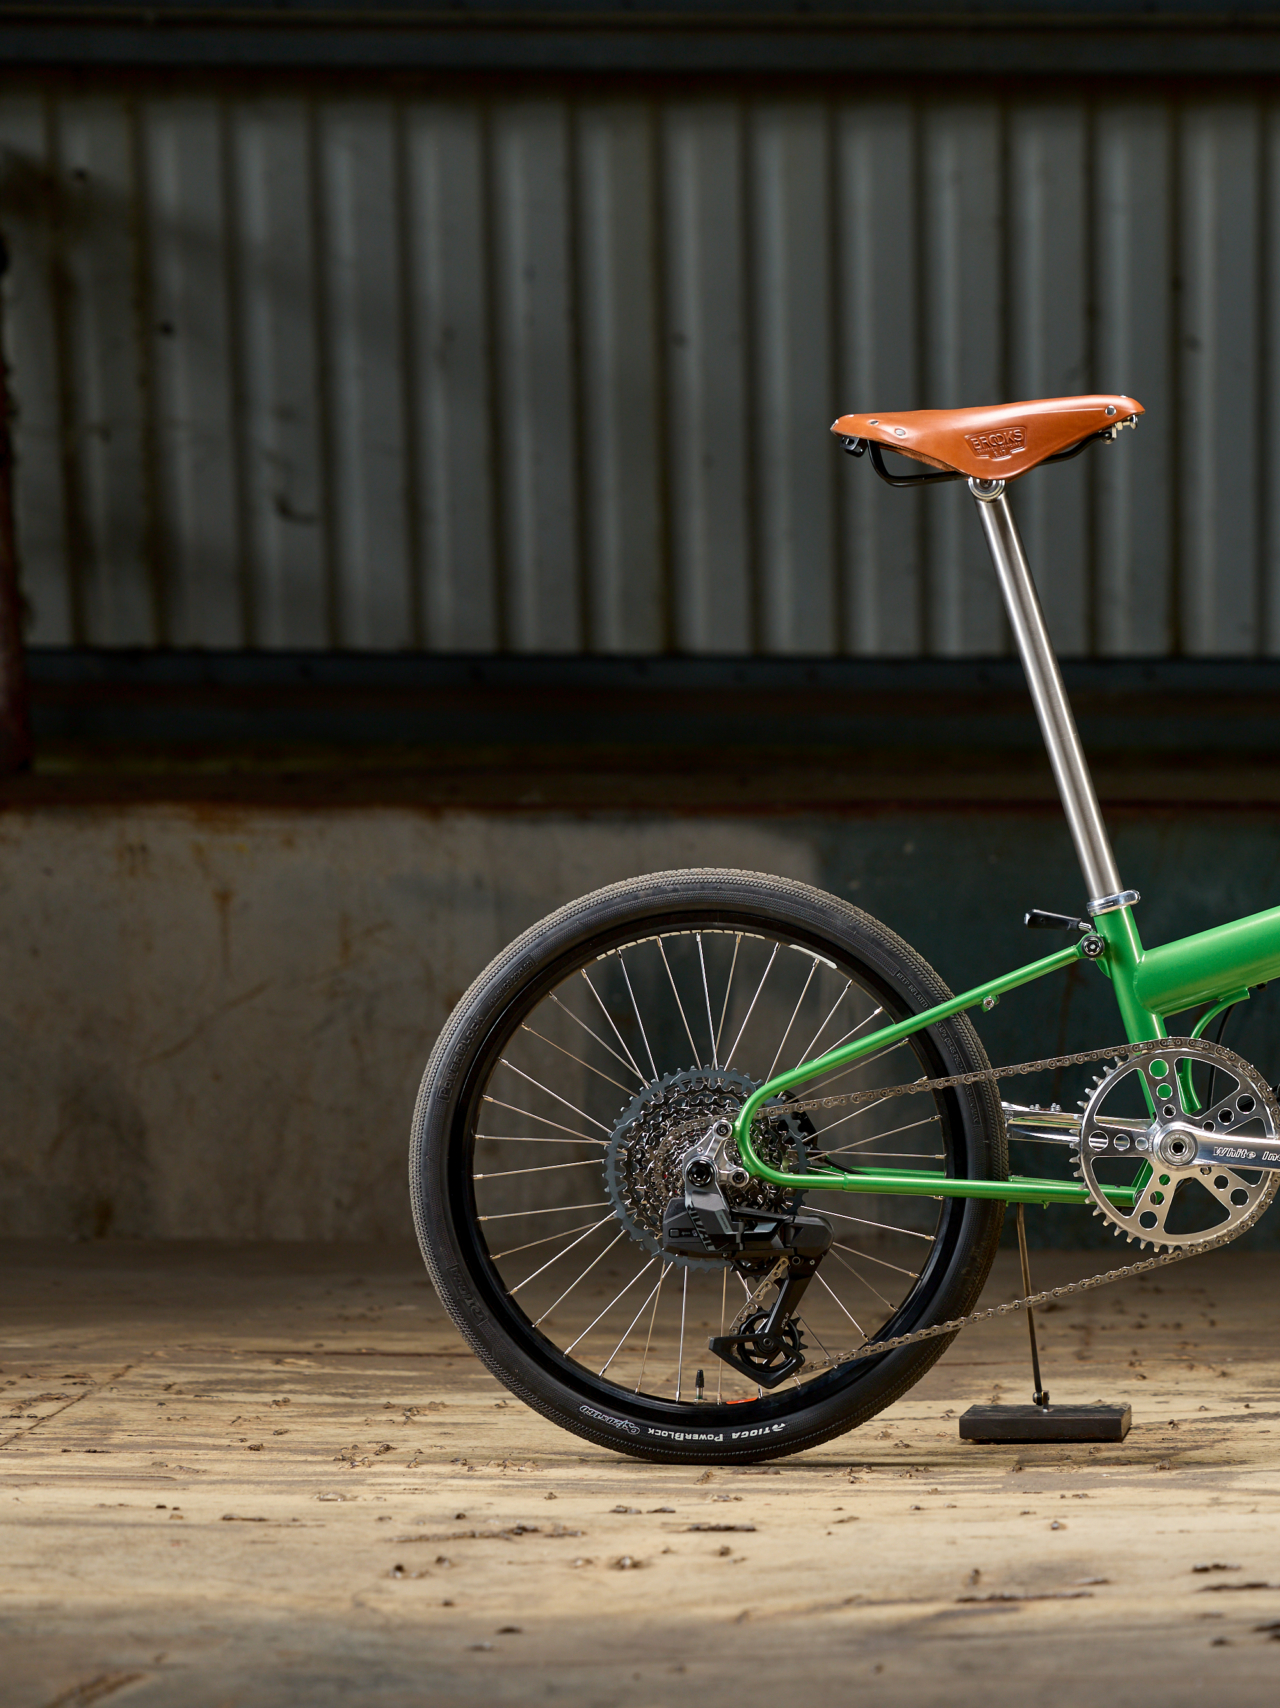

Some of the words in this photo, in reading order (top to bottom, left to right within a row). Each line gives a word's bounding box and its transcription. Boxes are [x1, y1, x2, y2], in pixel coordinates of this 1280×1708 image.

[970, 429, 1024, 449] BROOKS
[1213, 1146, 1256, 1159] White
[731, 1426, 771, 1439] TIOGA
